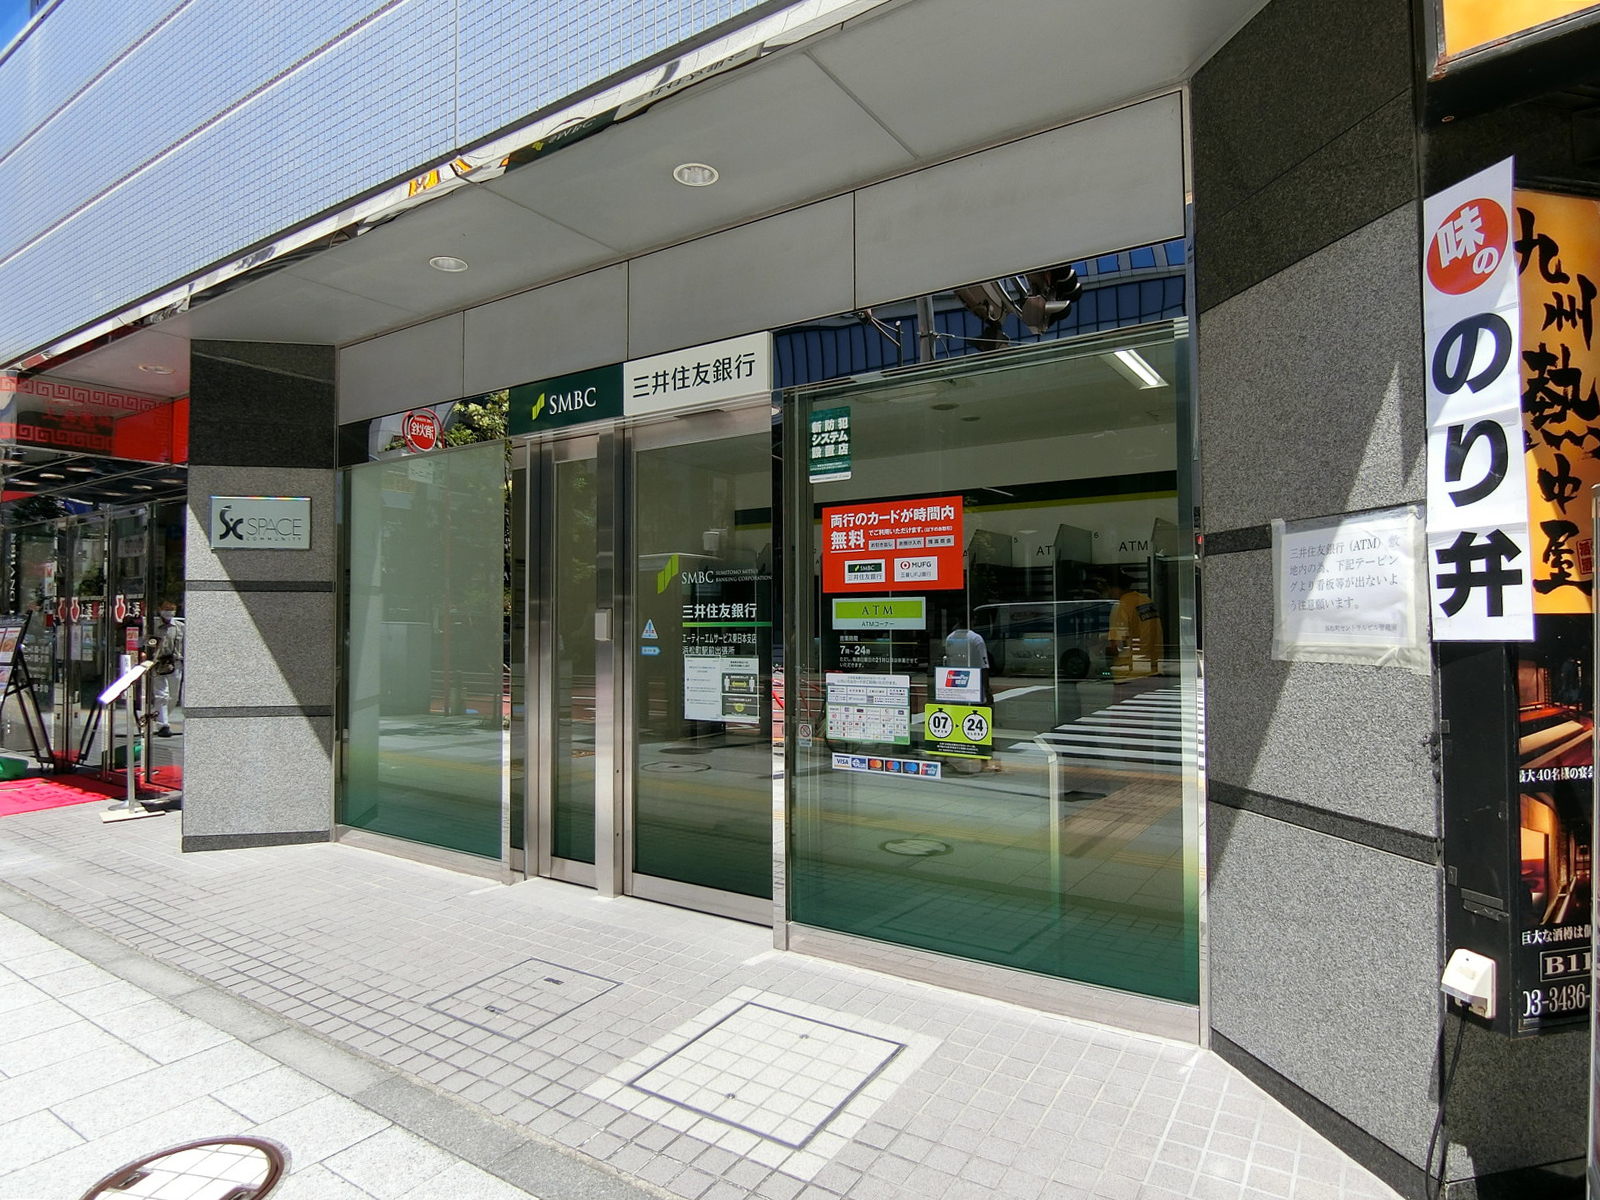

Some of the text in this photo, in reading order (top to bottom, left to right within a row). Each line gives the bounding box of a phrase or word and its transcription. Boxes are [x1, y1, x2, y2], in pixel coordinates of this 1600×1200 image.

[1437, 206, 1499, 275] 味の
[632, 352, 756, 399] 三井住友銀行
[549, 387, 597, 415] SMBC
[811, 417, 849, 433] 新防犯
[811, 430, 849, 446] システム
[811, 442, 849, 459] 設置店
[1432, 312, 1523, 618] のり弁
[830, 505, 955, 528] 両行のカードが時間内
[246, 517, 302, 536] SPACE
[830, 529, 865, 550] 無料
[1118, 540, 1149, 552] ATM
[1036, 545, 1052, 556] AT
[911, 560, 932, 568] MUFG
[681, 570, 714, 585] SMBC
[847, 573, 882, 581] 三井住友銀行
[682, 603, 757, 619] 三井住友銀行
[861, 605, 894, 616] ATM
[932, 715, 949, 729] 07
[967, 718, 984, 732] 24
